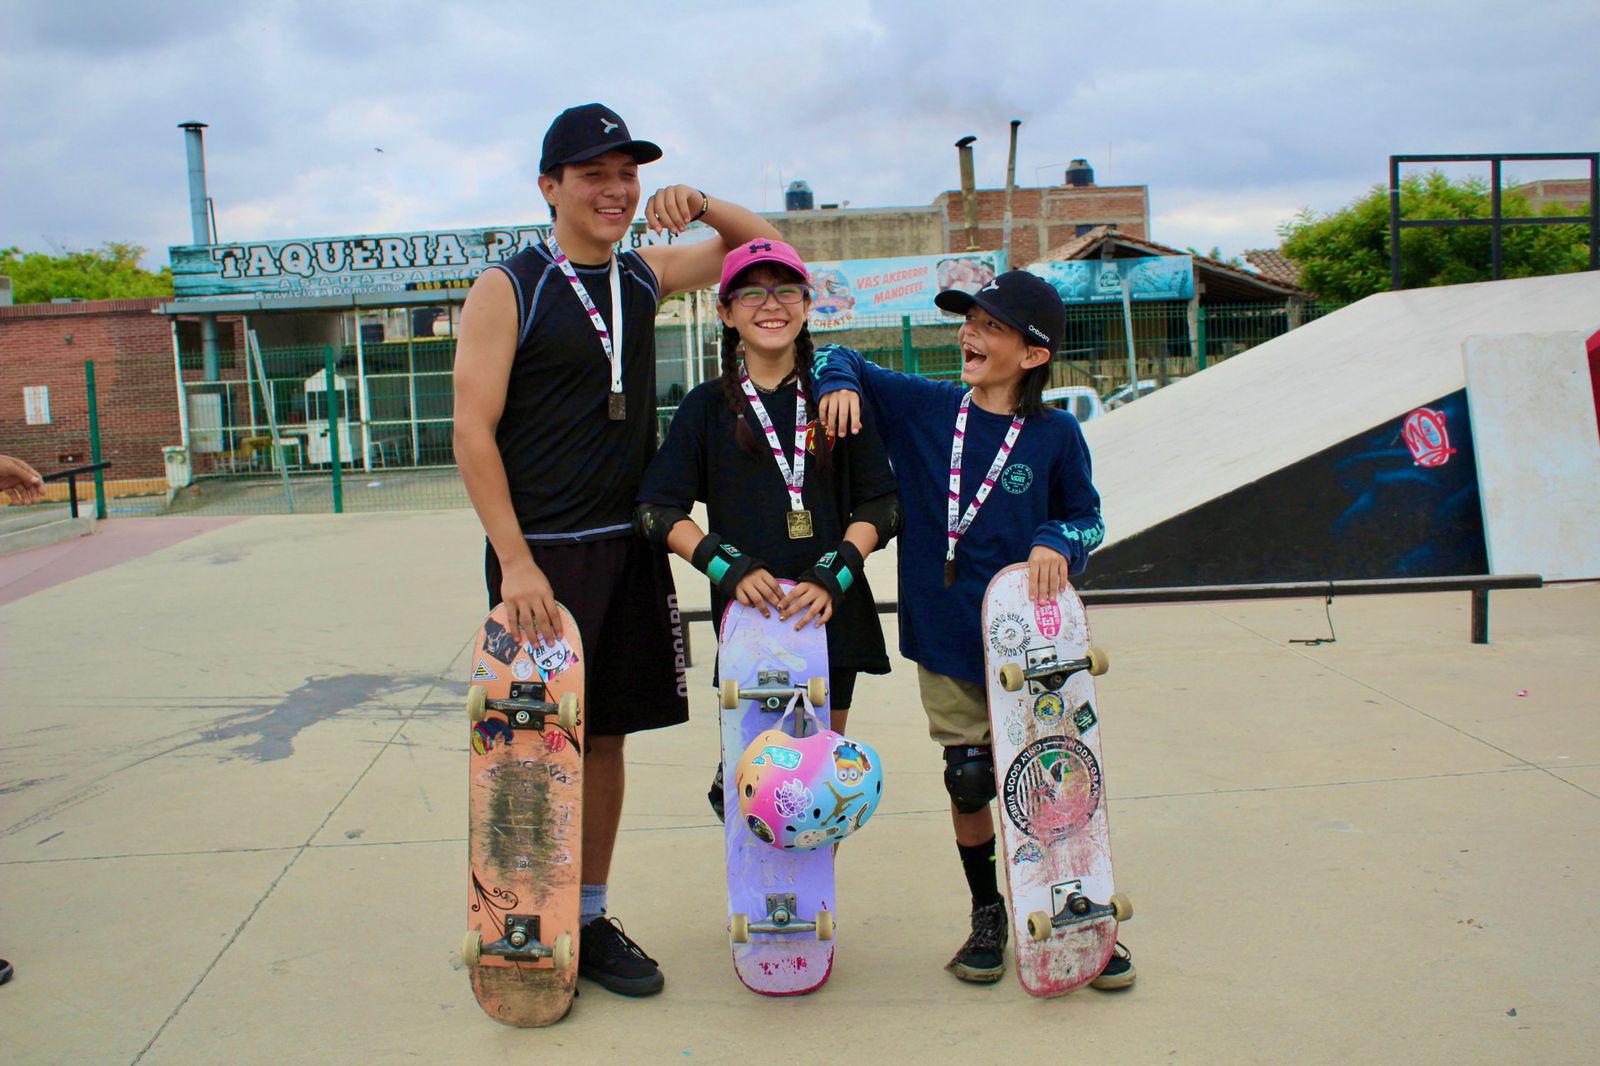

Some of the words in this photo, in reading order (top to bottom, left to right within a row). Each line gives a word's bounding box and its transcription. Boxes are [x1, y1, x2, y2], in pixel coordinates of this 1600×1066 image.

[213, 235, 469, 278] TAQUERIA
[392, 268, 481, 281] PASTO
[857, 275, 879, 290] VAS
[1021, 744, 1042, 763] ONLY
[1007, 763, 1021, 792] GOOD
